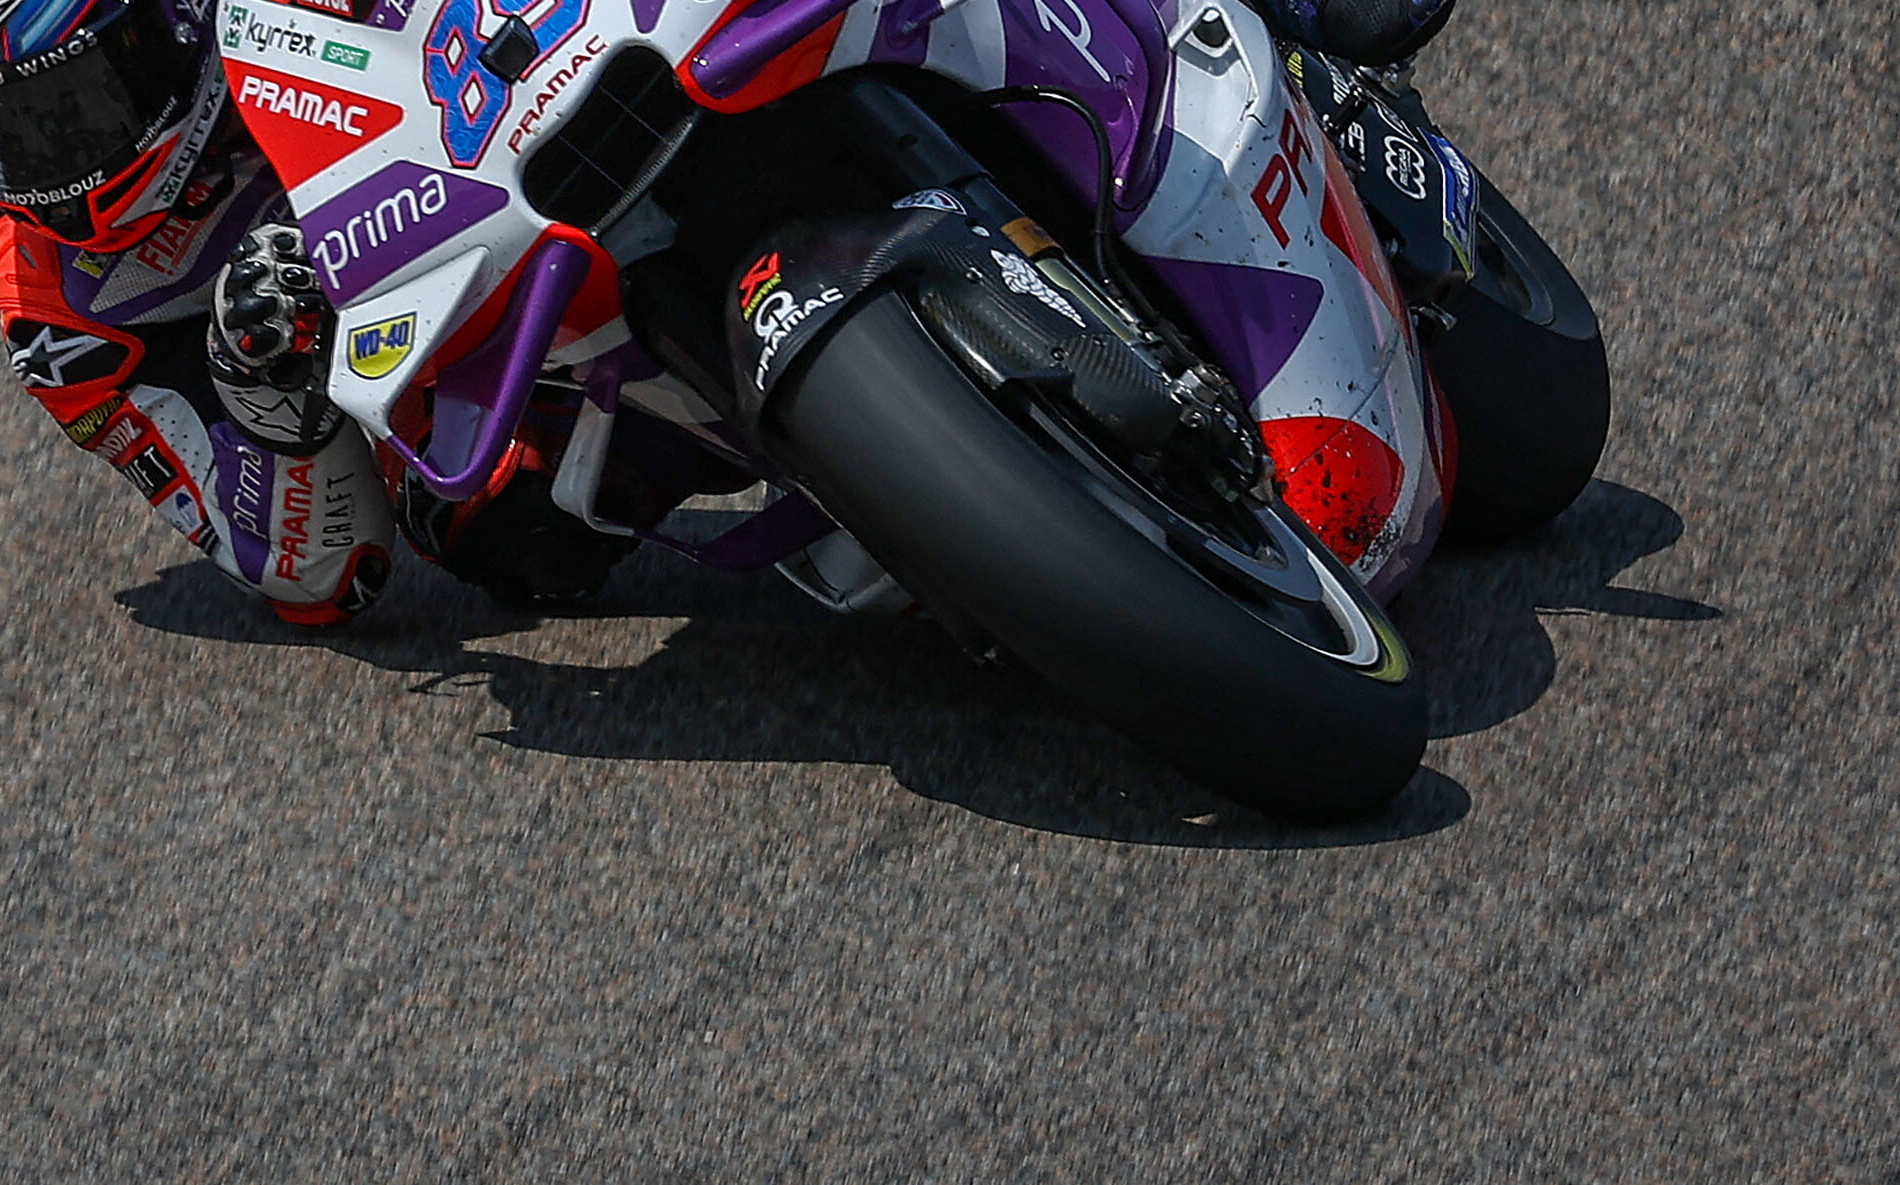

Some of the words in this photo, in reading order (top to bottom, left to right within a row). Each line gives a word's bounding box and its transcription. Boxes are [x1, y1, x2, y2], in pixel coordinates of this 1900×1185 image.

[15, 29, 98, 77] WINGS
[326, 46, 364, 66] SPORT
[238, 76, 369, 137] PRAMAC
[507, 34, 610, 154] PRAMAC
[4, 170, 107, 205] MOTOBLOUZ
[312, 172, 448, 290] prima
[354, 321, 409, 360] WD-40
[233, 445, 268, 540] prima
[275, 457, 315, 582] PRAMA
